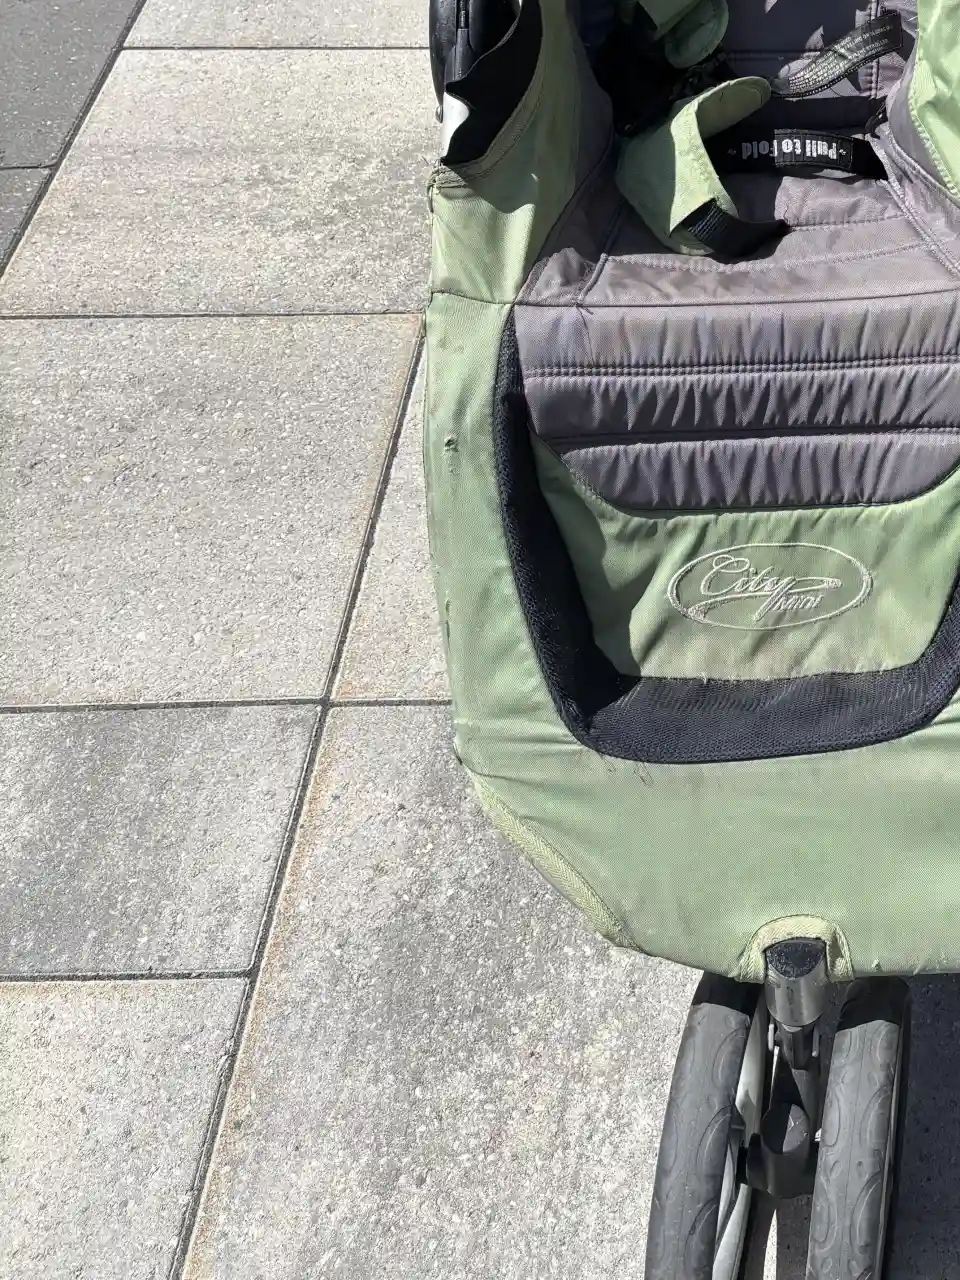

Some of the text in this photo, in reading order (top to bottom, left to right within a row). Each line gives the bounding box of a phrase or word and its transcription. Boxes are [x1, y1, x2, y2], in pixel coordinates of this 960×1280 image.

[741, 138, 837, 160] Pull to Fold
[700, 554, 818, 622] City
